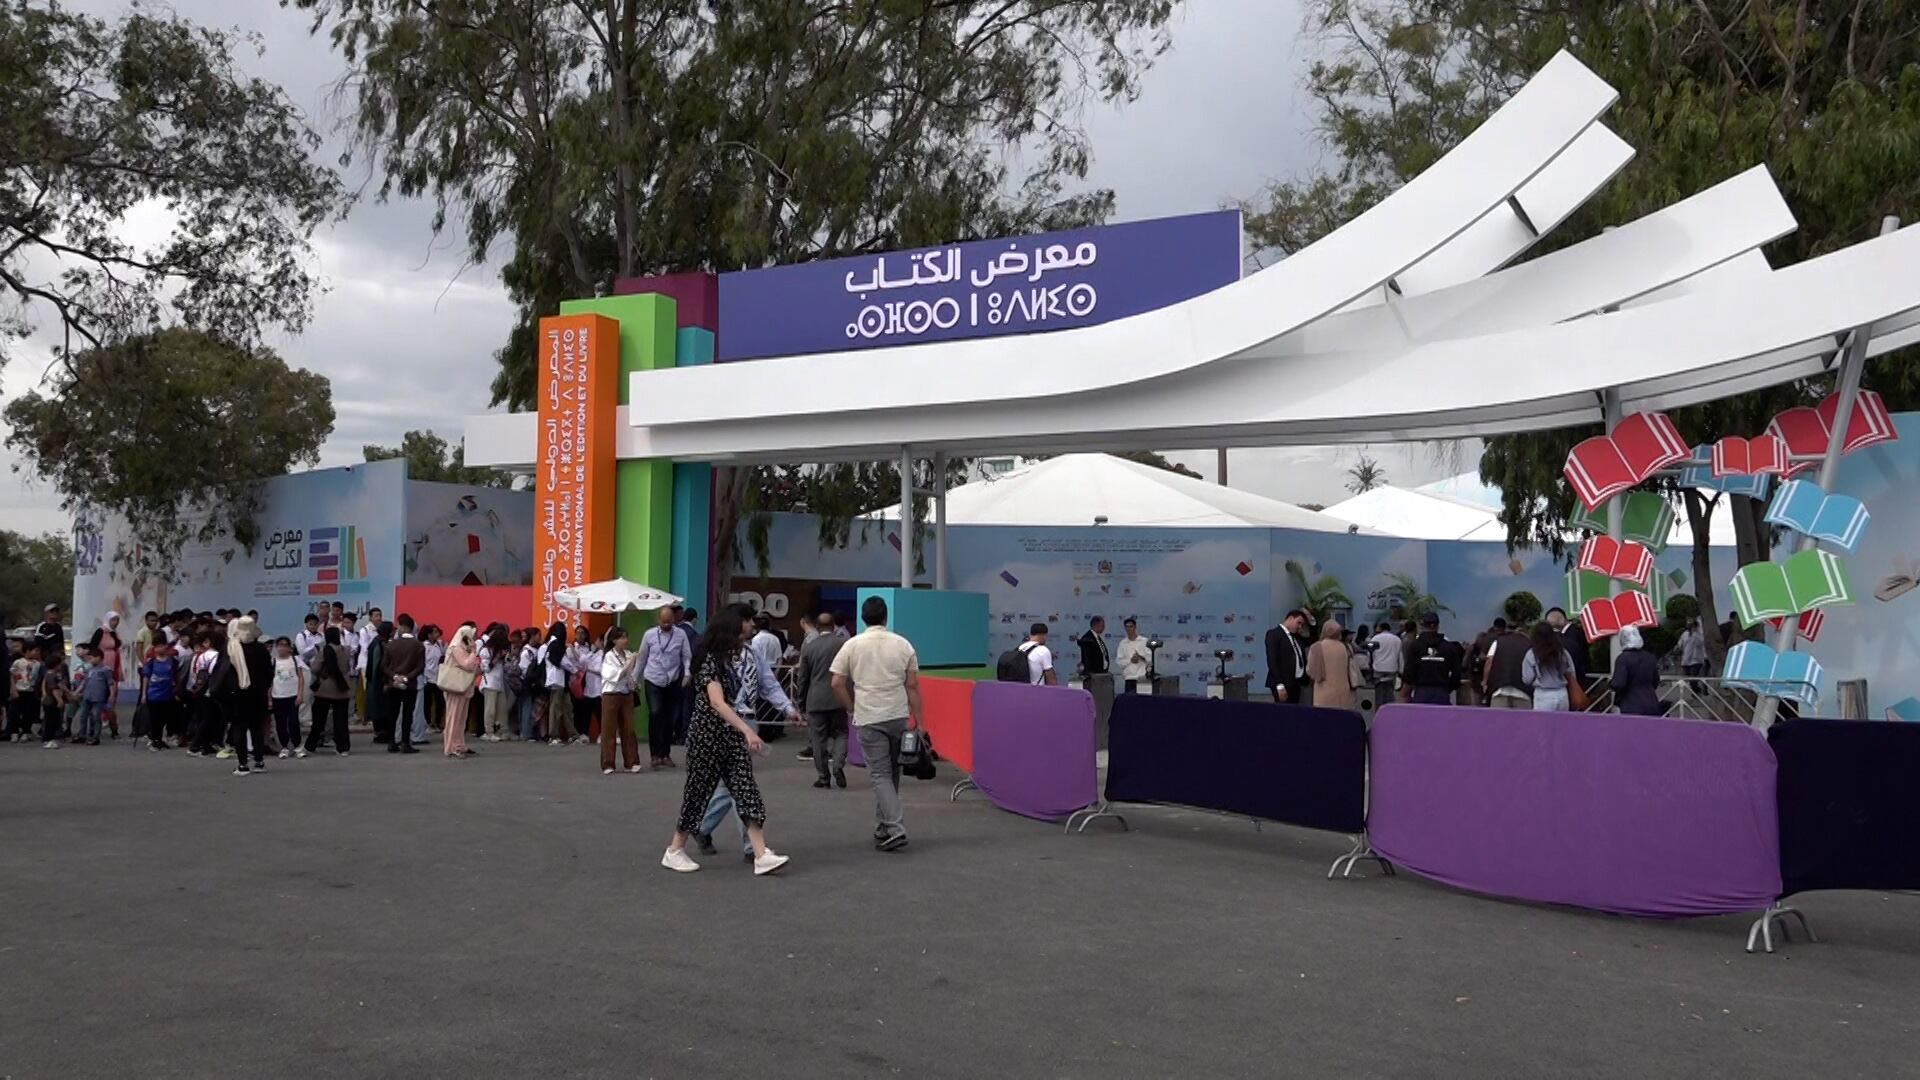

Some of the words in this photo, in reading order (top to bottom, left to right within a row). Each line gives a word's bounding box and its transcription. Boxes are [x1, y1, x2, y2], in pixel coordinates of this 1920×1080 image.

[845, 247, 961, 300] الكتاب
[970, 241, 1097, 287] معرض
[579, 327, 588, 362] LIVRE
[547, 329, 560, 410] المعرض
[578, 365, 587, 382] DU
[577, 385, 586, 400] ET
[576, 403, 586, 462] L'EDITION
[545, 418, 558, 492] الدولي
[575, 465, 584, 482] DE
[265, 528, 302, 550] معرض
[542, 499, 557, 540] للنشر
[573, 484, 584, 584] INTERNATIONAL
[264, 549, 302, 575] الكتاب
